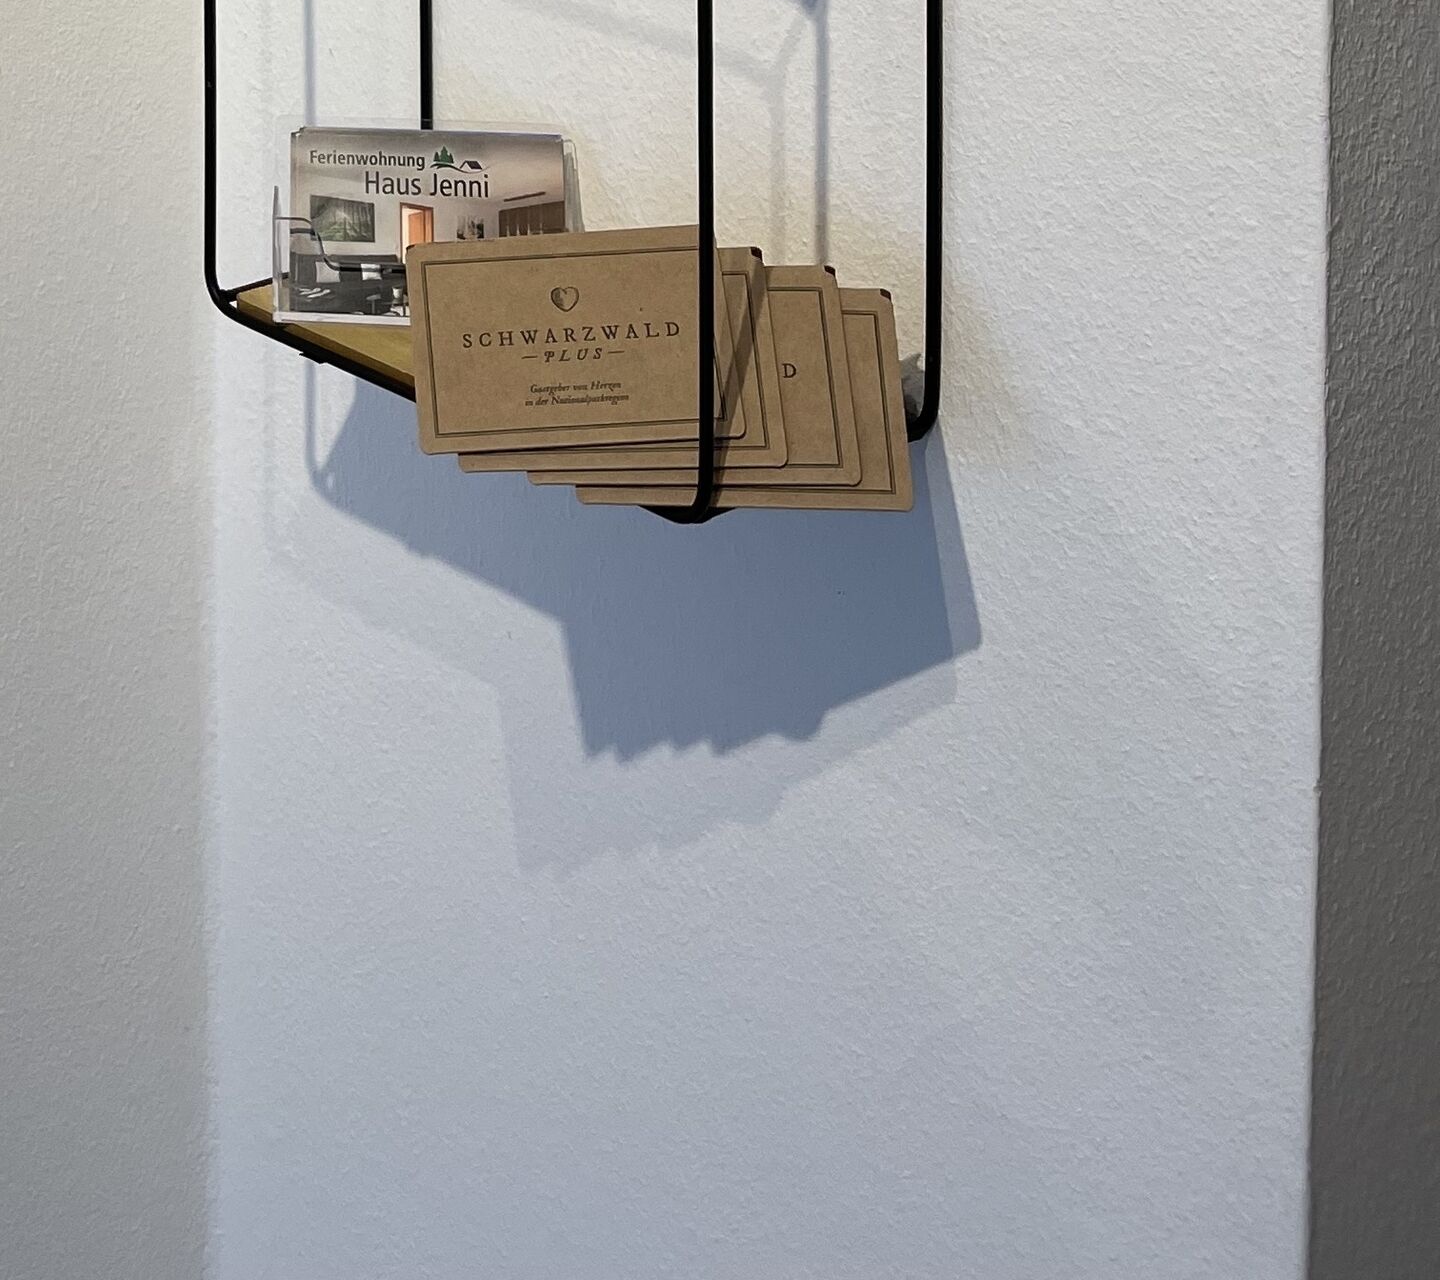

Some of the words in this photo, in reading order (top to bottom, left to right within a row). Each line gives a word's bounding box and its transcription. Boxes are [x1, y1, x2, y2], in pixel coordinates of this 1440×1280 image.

[309, 149, 425, 172] Ferienwohnung
[364, 171, 422, 196] Haus
[429, 173, 489, 199] Jenni
[462, 320, 681, 349] SCHWARZWALD
